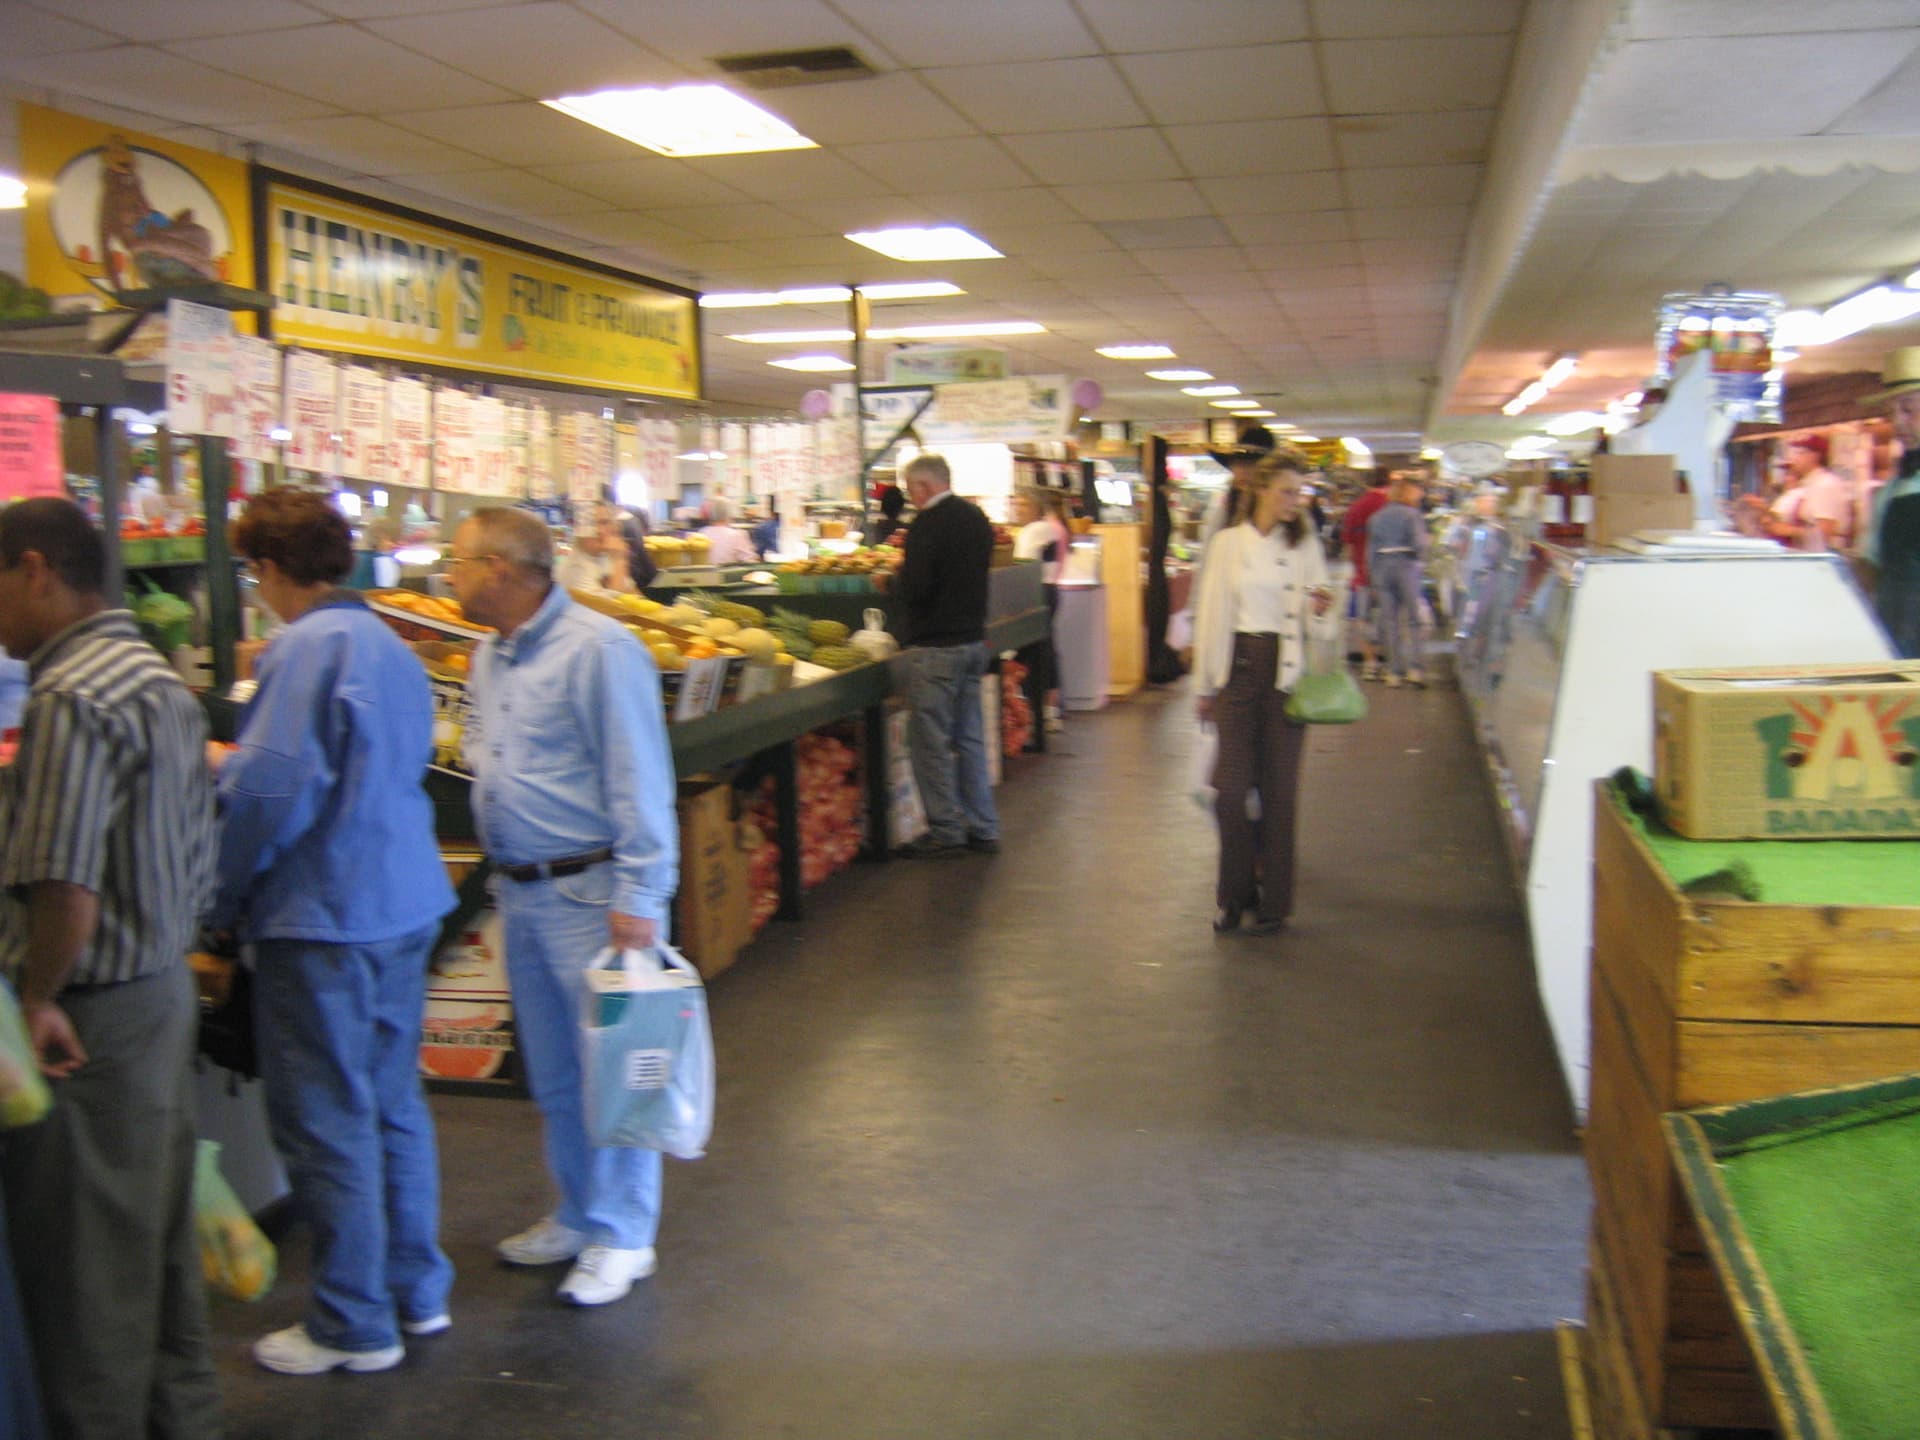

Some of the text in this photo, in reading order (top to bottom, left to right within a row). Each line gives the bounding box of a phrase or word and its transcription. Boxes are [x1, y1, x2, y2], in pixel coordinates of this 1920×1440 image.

[279, 208, 483, 342] HENRY'S
[509, 273, 571, 324] FRUIT
[1766, 808, 1920, 834] BANANA
